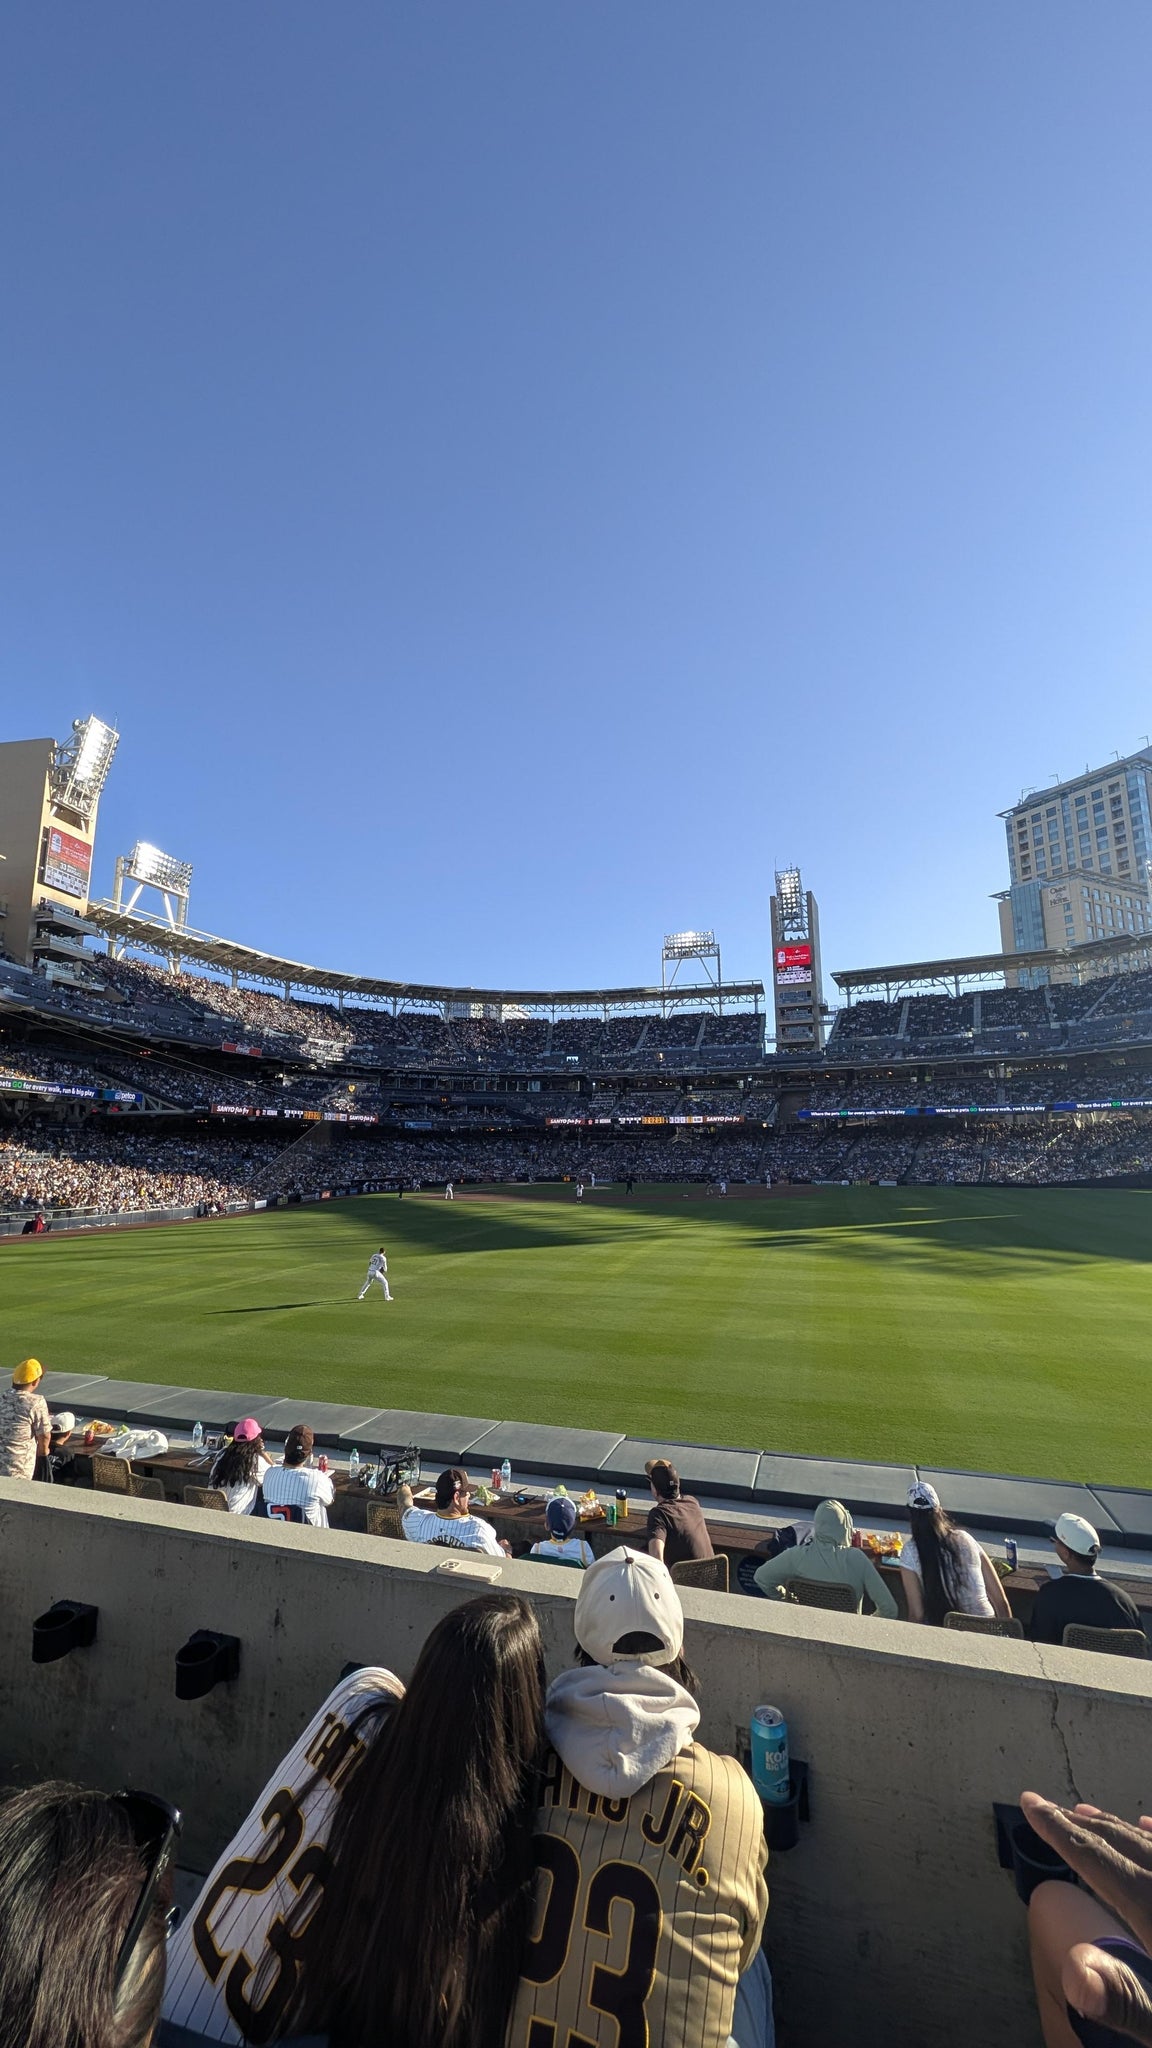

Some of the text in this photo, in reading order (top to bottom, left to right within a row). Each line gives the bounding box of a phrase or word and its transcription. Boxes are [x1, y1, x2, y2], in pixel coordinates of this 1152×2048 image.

[32, 1084, 48, 1092] every
[76, 1088, 84, 1096] big
[84, 1089, 95, 1098] play
[121, 1092, 136, 1100] petco
[640, 1779, 712, 1889] JR.
